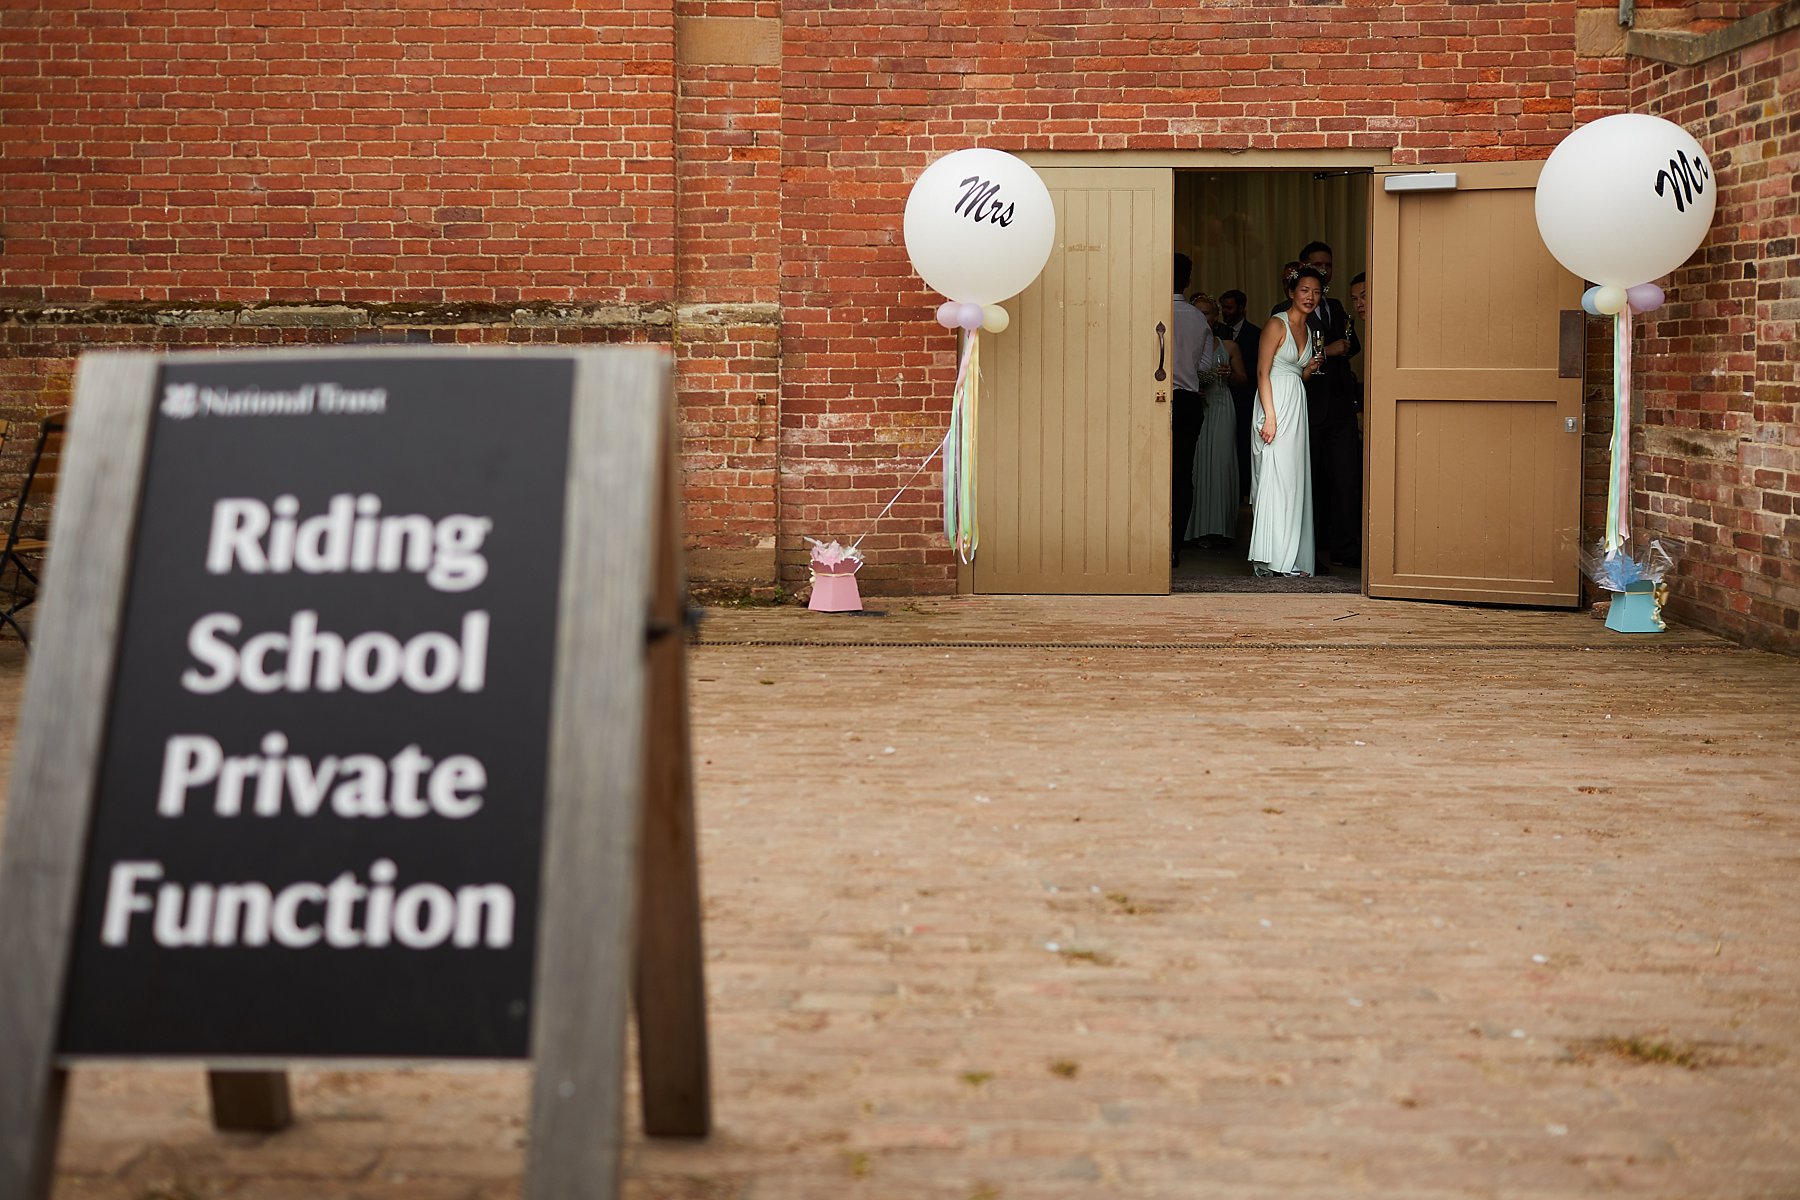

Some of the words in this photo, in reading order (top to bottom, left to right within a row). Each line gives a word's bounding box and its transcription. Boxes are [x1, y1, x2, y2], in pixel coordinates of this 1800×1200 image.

[954, 175, 1016, 228] Mrs
[1654, 149, 1709, 213] Mr
[199, 383, 316, 417] National
[317, 382, 389, 415] Trust
[206, 494, 492, 591] Riding
[182, 610, 490, 693] School
[158, 732, 487, 818] Private
[102, 860, 514, 948] Function
